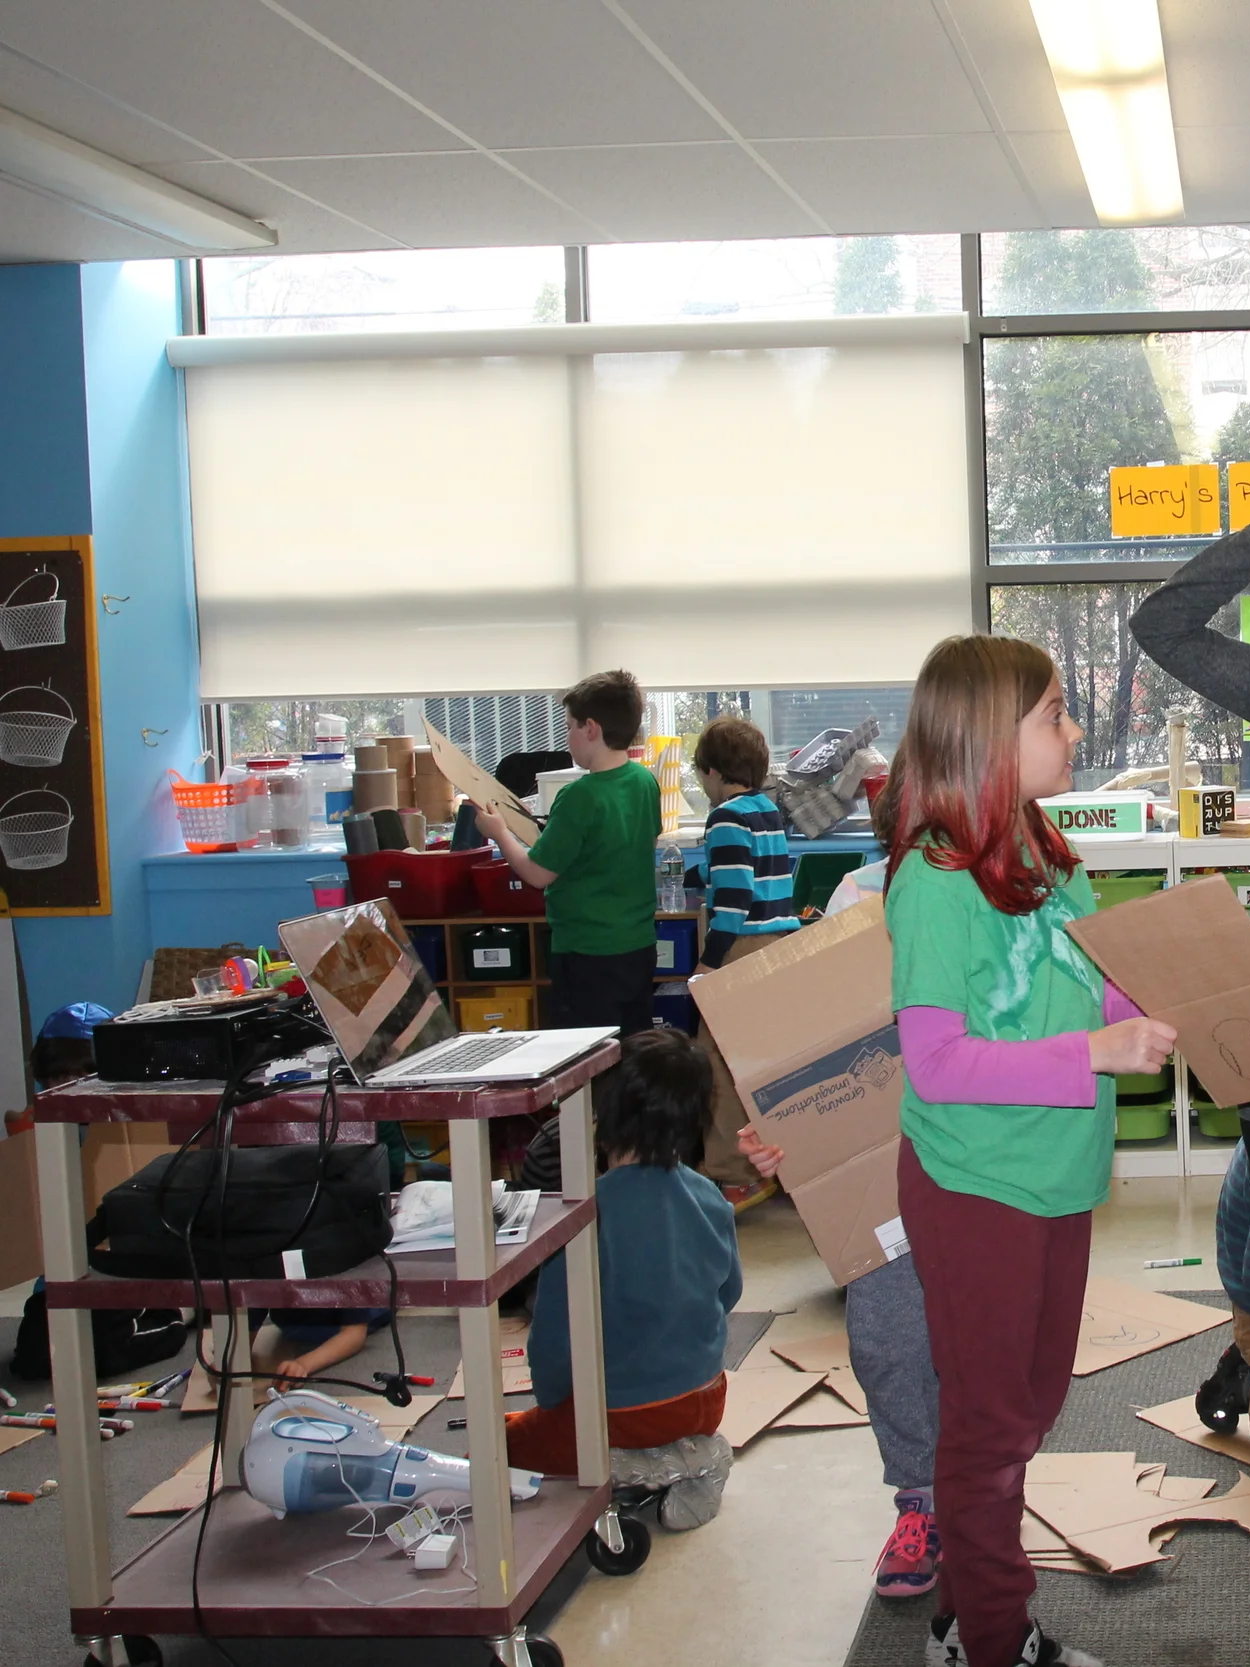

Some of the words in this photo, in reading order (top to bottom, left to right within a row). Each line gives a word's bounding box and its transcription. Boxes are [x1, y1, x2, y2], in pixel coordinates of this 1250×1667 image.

[1117, 481, 1213, 518] Harry's
[1058, 808, 1117, 830] DONE
[815, 1086, 866, 1116] Growing
